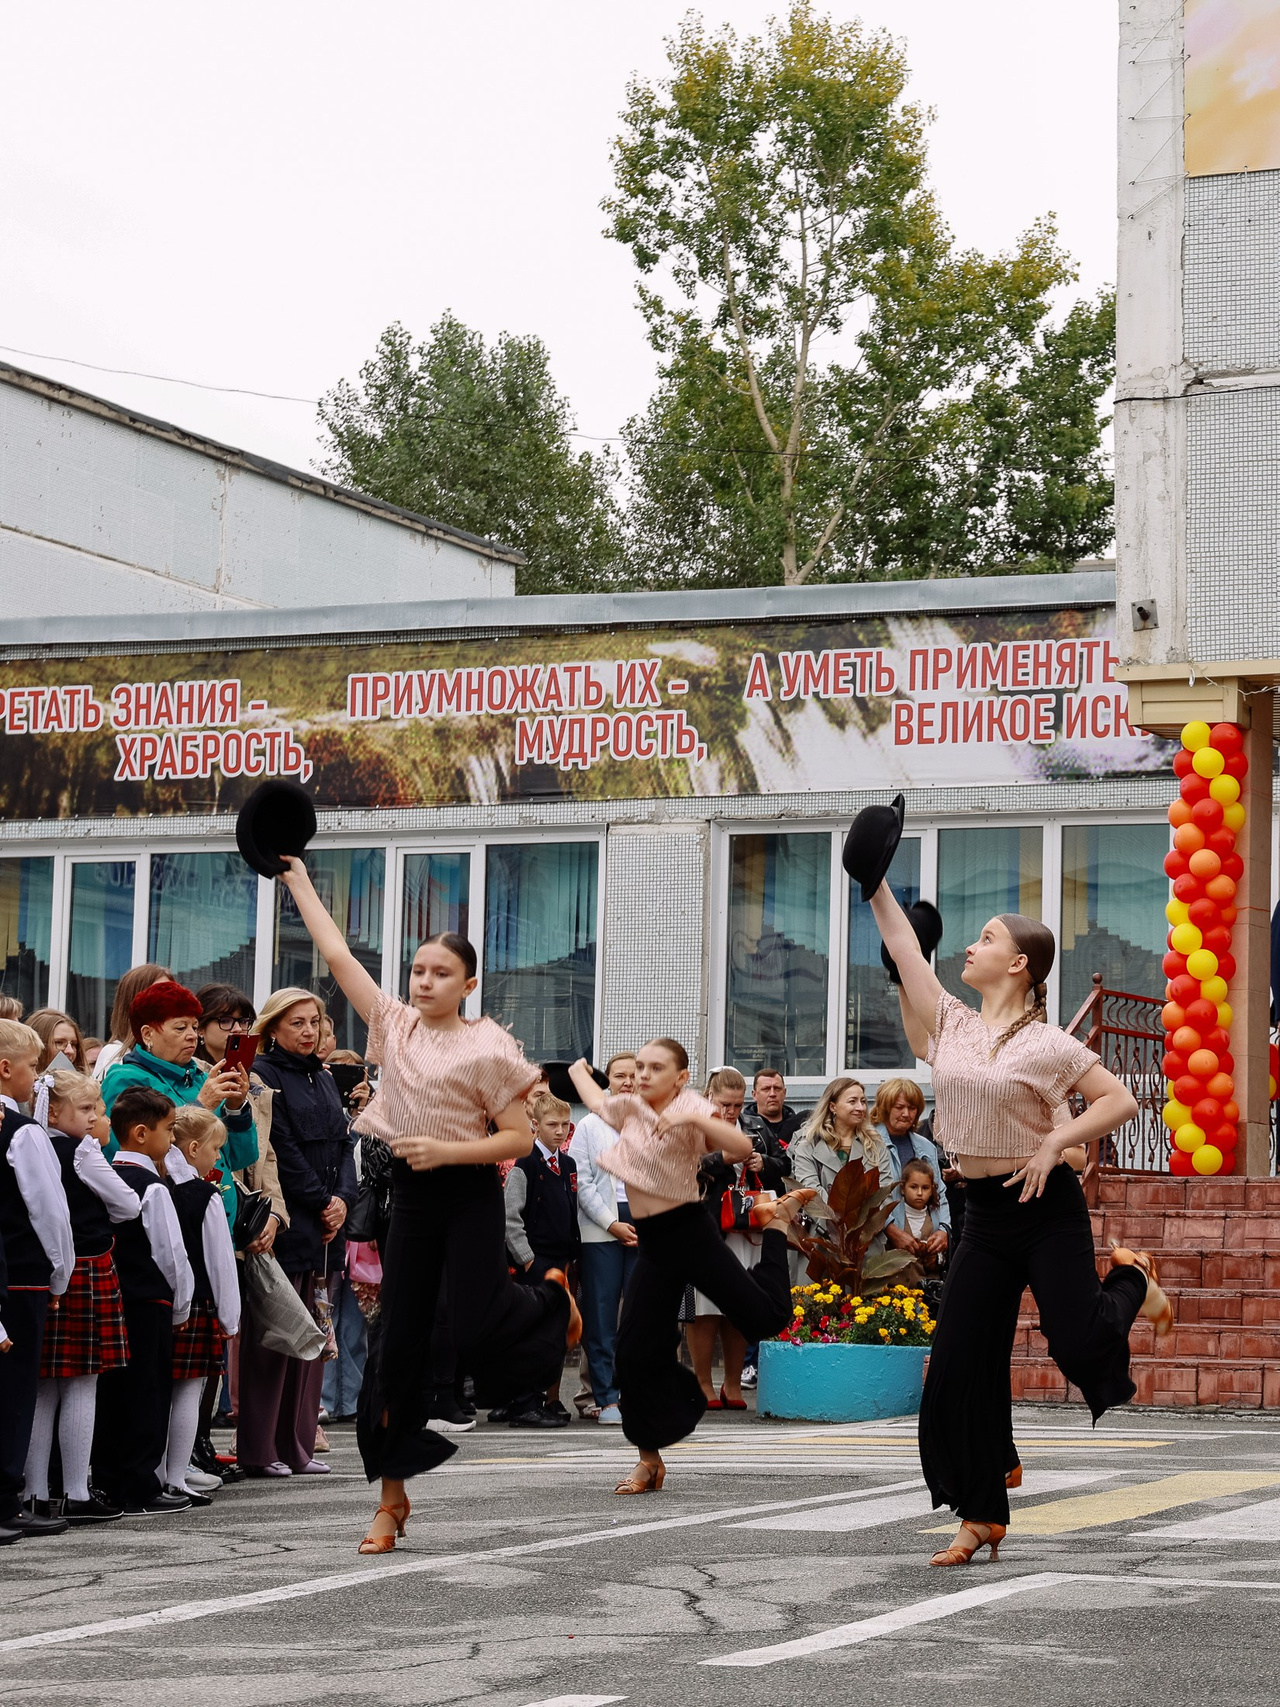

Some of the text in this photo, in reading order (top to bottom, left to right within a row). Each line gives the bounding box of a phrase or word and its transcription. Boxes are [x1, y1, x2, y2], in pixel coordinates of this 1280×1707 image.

[350, 664, 602, 718] ПРИУМНОЖАТЬ
[616, 660, 660, 706] ИХ
[746, 640, 1120, 699] А УМЕТЬ ПРИМЕНЯТЬ
[112, 681, 240, 728] ЗНАНИЯ
[894, 696, 1056, 746] ВЕЛИКОЕ
[116, 730, 311, 780] ХРАБРОСТЬ,
[517, 713, 706, 768] МУДРОСТЬ,
